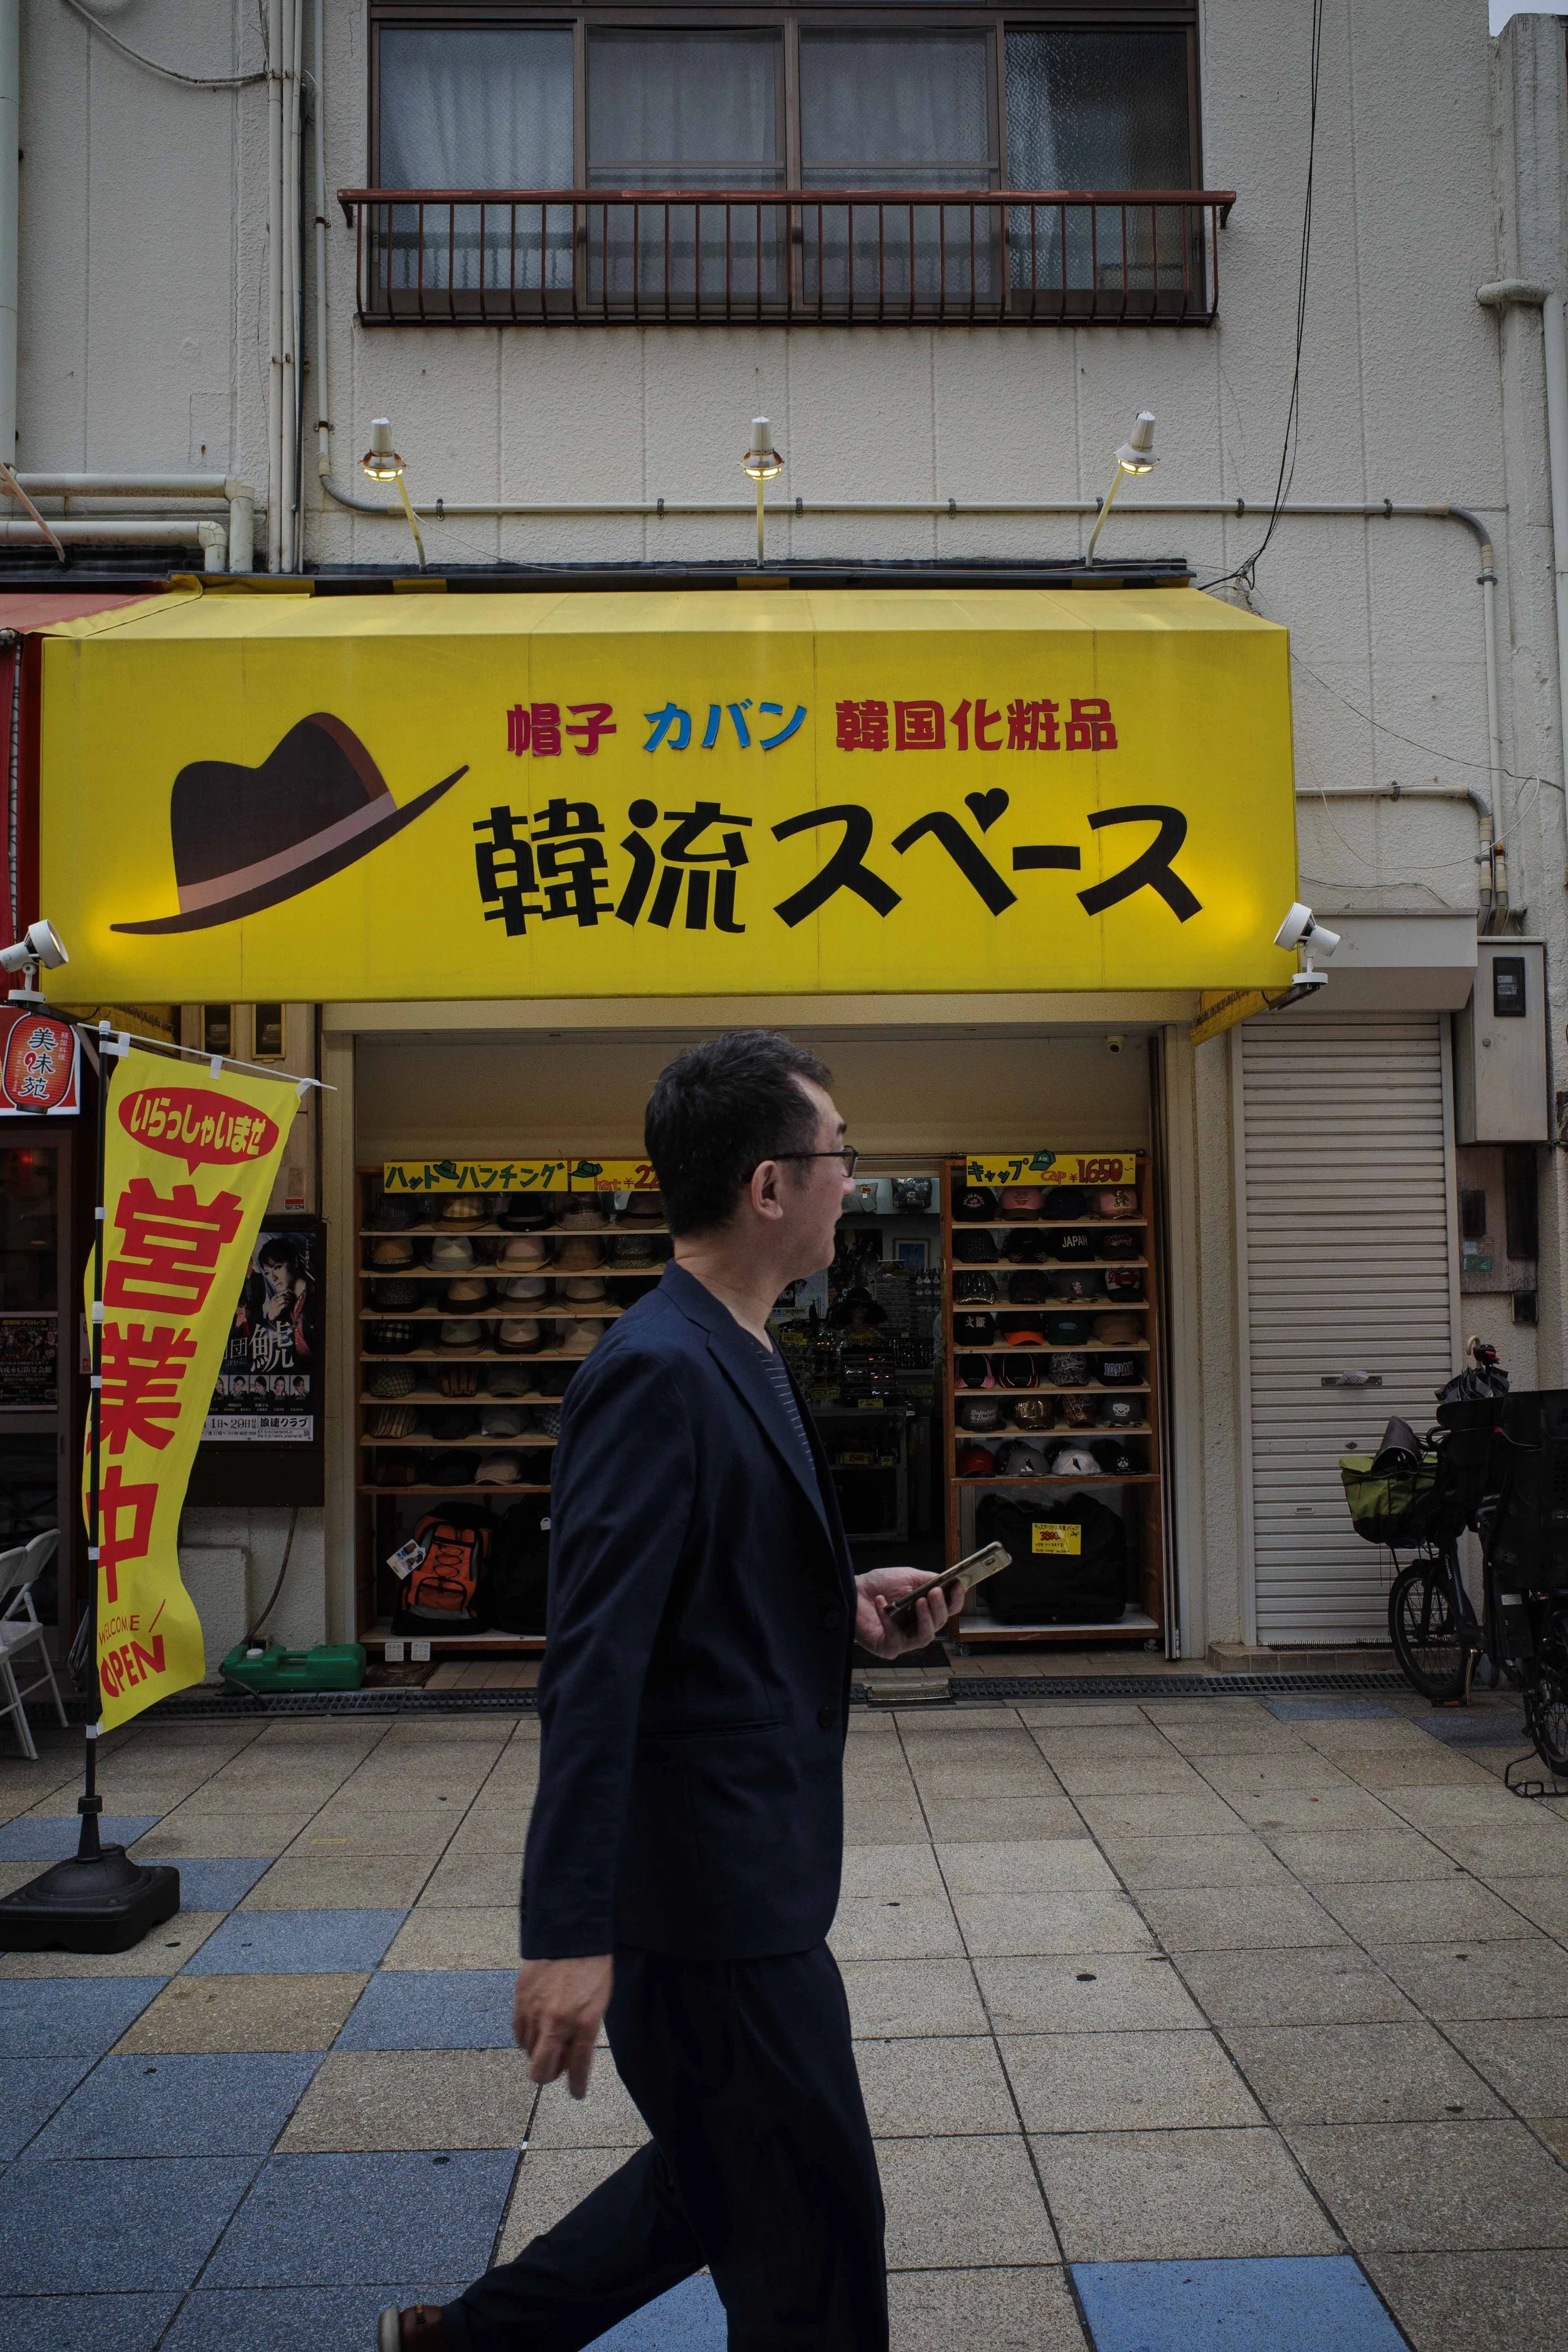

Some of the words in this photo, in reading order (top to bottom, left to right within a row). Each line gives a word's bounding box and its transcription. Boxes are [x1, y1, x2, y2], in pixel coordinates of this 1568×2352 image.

[507, 702, 617, 756] 帽子
[642, 698, 808, 751] カバン
[835, 698, 1119, 753] 韓国化粧品
[130, 1094, 266, 1156] いらっしゃいませ
[385, 1165, 440, 1190] ハット
[456, 1162, 565, 1189] ハンチング
[593, 1175, 621, 1191] hat
[968, 1158, 1029, 1184] キャップ
[1040, 1170, 1066, 1187] cap
[1061, 1234, 1089, 1248] JAPAN
[965, 1316, 987, 1328] 大阪
[1103, 1361, 1135, 1377] JAPAN
[86, 1177, 244, 1603] 営業中
[260, 1417, 308, 1428] 浪速クラブ
[98, 1614, 140, 1646] WELCOME
[100, 1634, 166, 1698] OPEN
